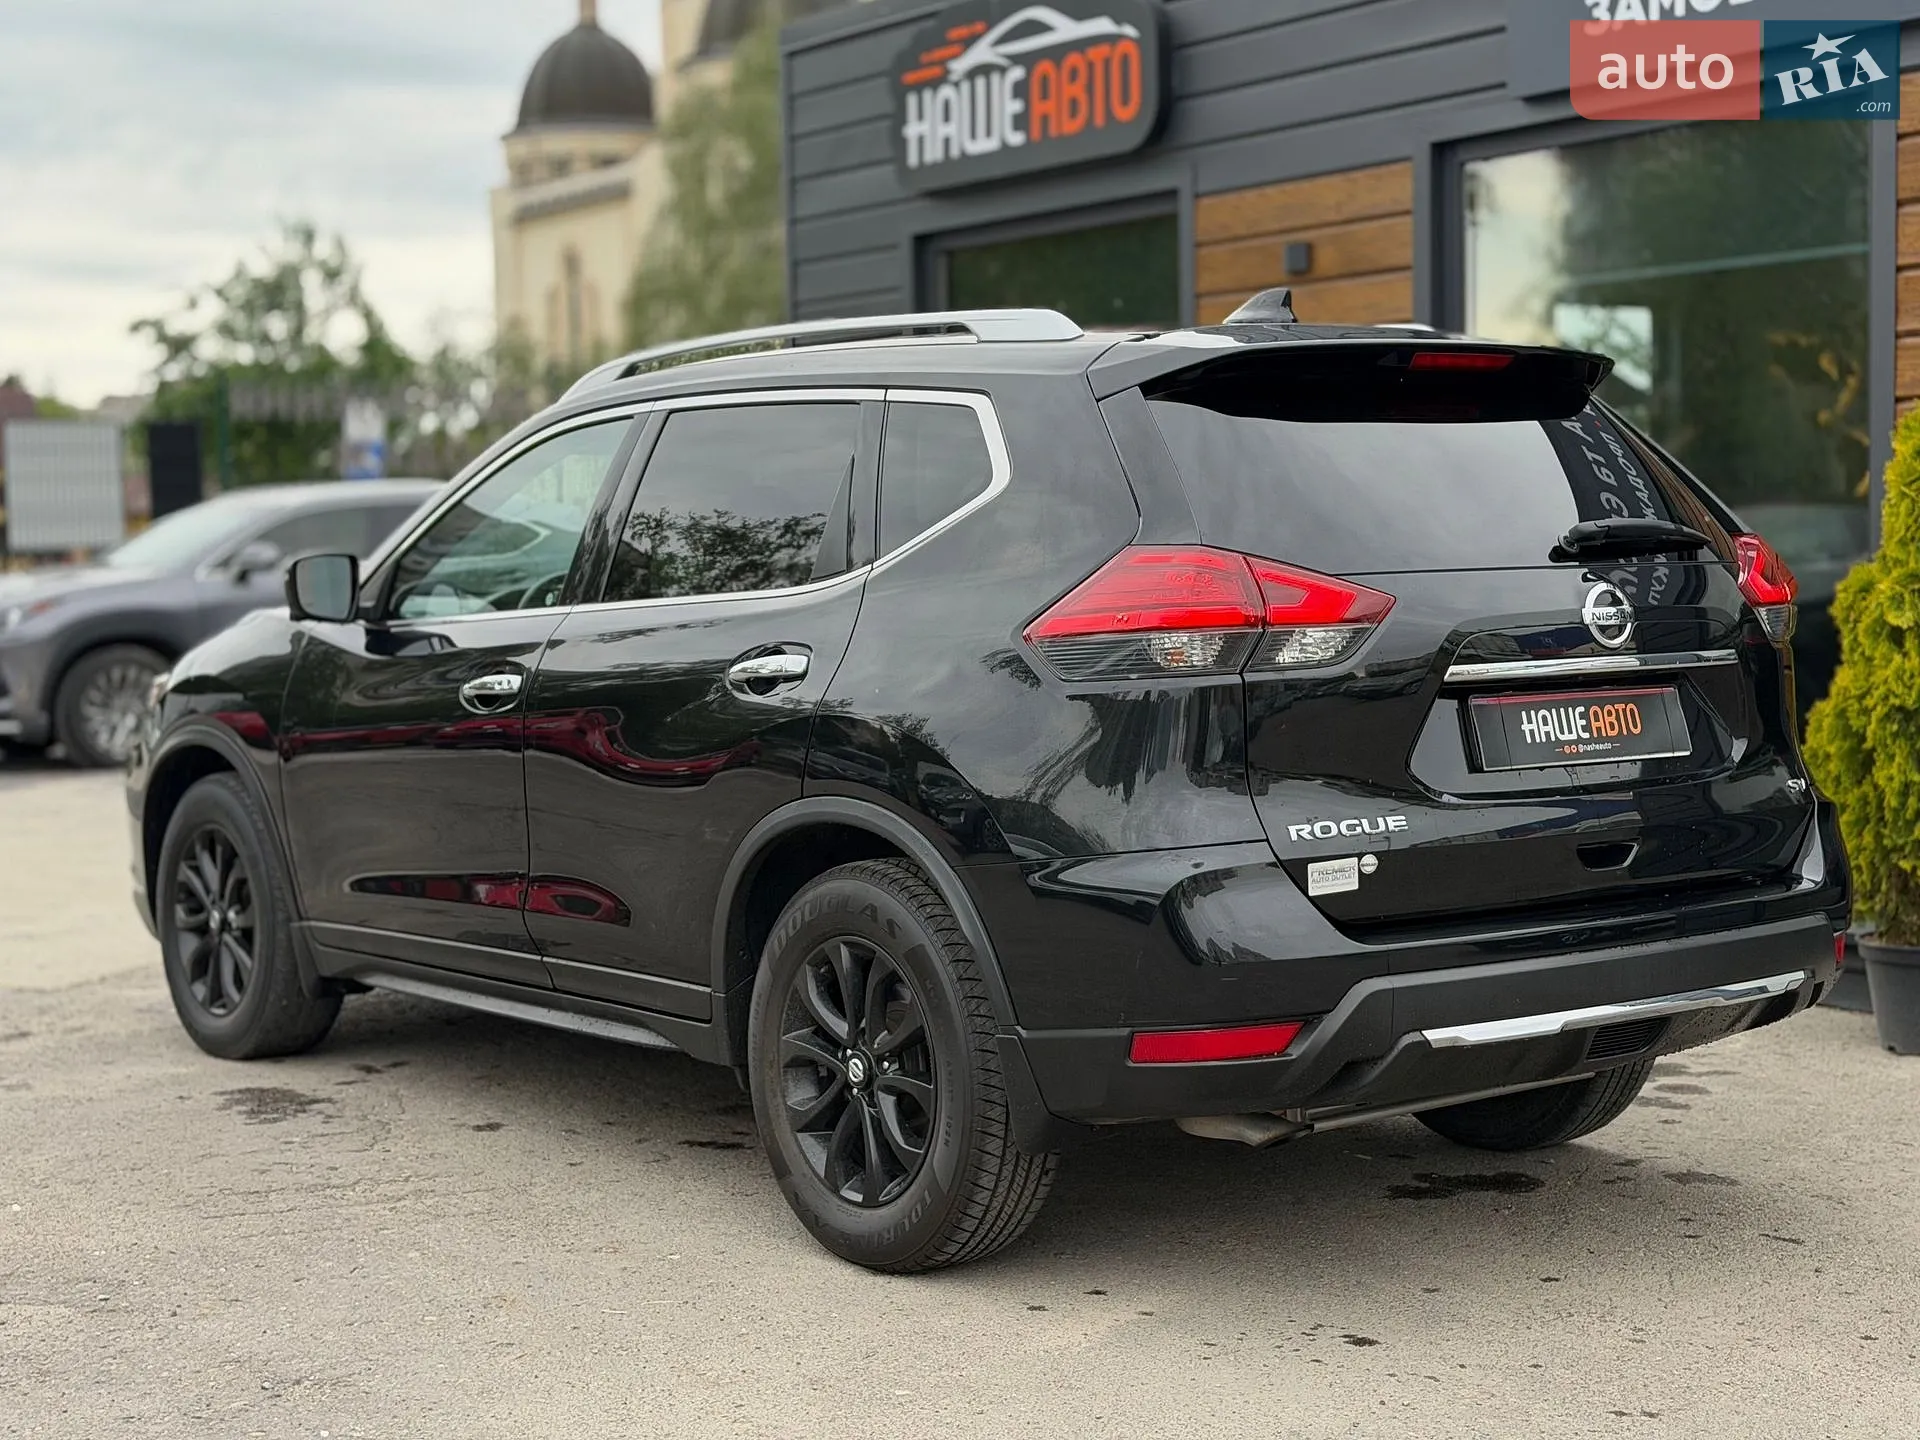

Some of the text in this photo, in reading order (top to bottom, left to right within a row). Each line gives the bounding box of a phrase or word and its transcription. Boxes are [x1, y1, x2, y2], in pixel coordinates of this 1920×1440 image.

[1592, 607, 1632, 621] NISSAN
[1288, 815, 1408, 841] ROGUE
[1312, 872, 1356, 884] AUTO OUTLET
[773, 892, 902, 958] DOUGLAS
